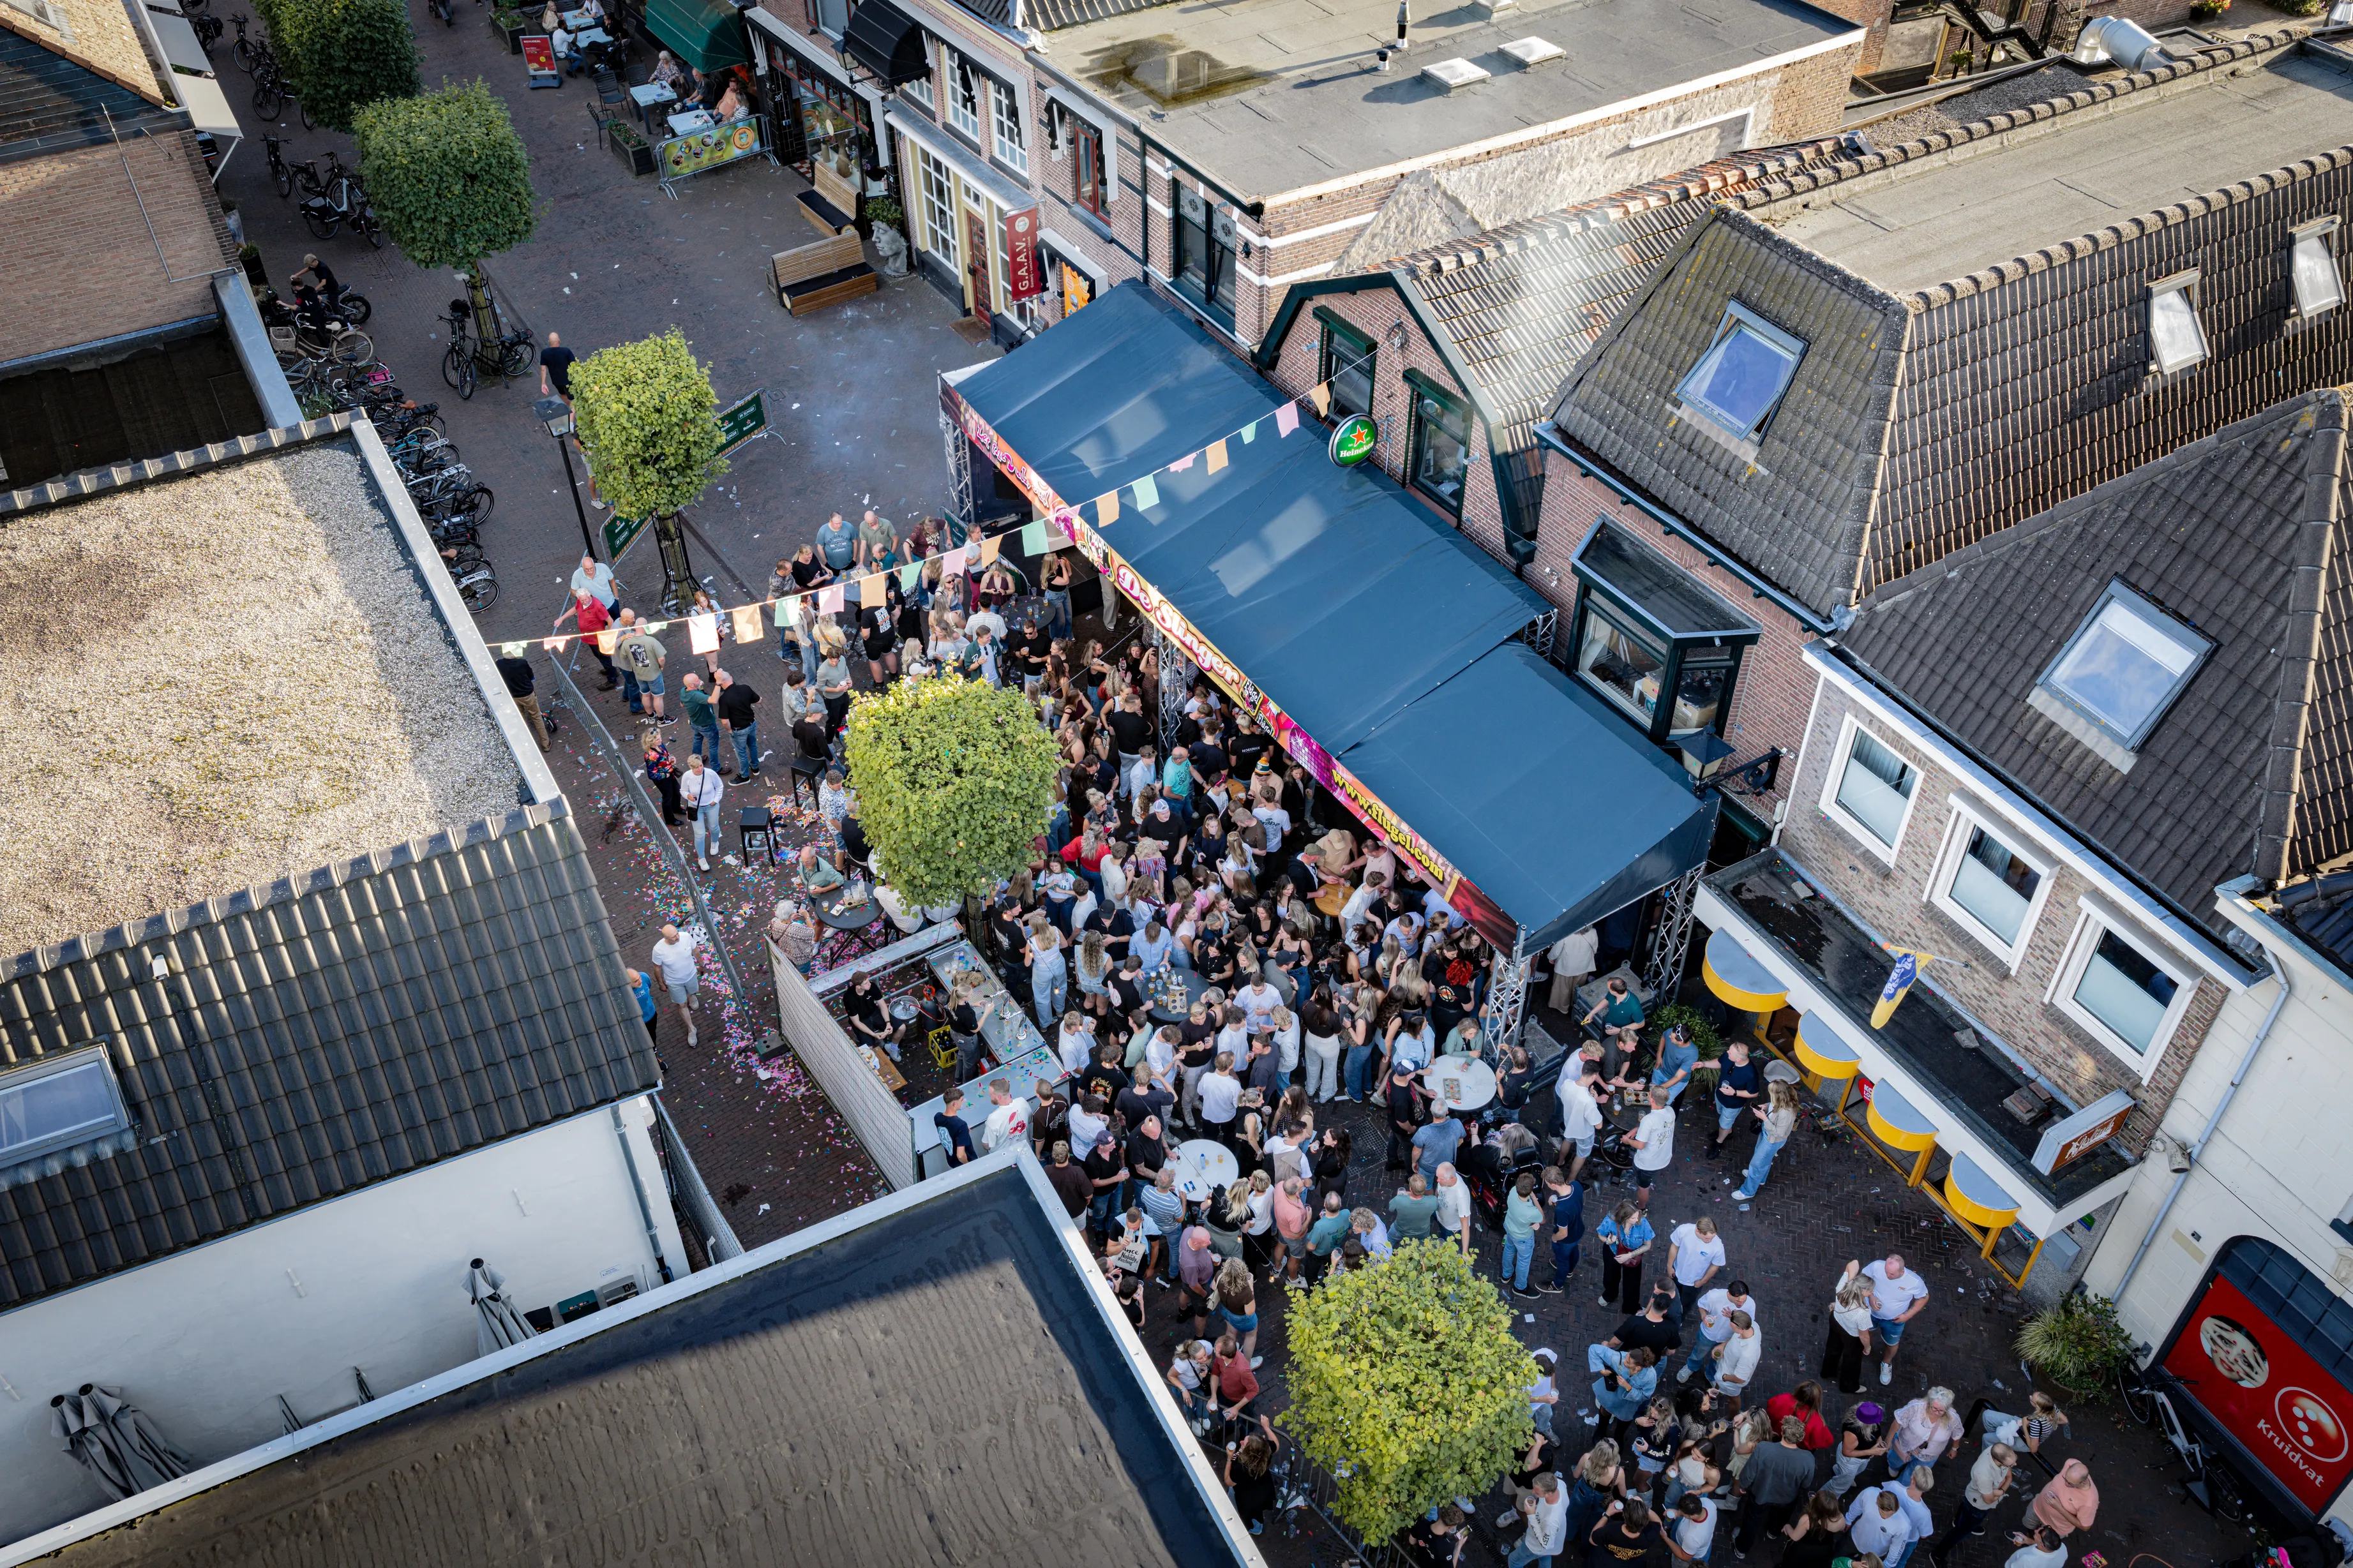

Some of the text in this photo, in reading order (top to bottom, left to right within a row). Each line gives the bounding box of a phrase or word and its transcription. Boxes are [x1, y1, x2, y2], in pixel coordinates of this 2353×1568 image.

[1016, 237, 1029, 291] G.A.A.V.
[1339, 441, 1374, 458] Heineken
[1117, 565, 1240, 685] De Slinger
[1244, 678, 1262, 705] Flügel
[1332, 768, 1445, 883] www.flugel.com
[1117, 1257, 1133, 1266] Watching
[1121, 1252, 1138, 1263] Nobody
[622, 1281, 636, 1293] 13A
[2257, 1419, 2324, 1488] Kruidvat
